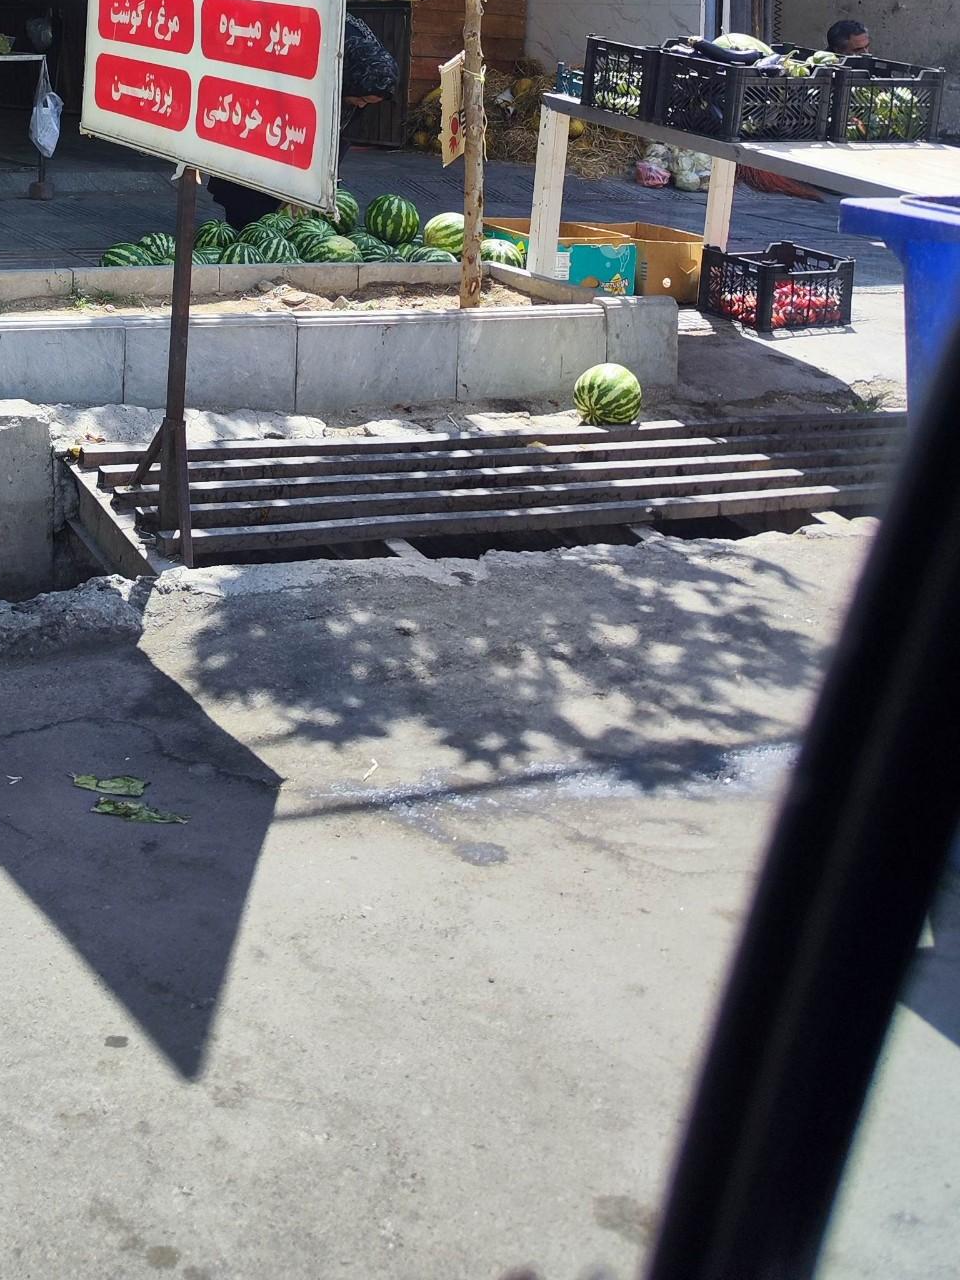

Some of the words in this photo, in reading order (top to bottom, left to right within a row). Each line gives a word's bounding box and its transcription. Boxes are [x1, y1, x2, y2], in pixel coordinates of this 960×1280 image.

[154, 0, 181, 42] مرغ
[219, 12, 263, 48] میوه
[264, 20, 303, 56] سوپر
[265, 113, 307, 151] سبزی
